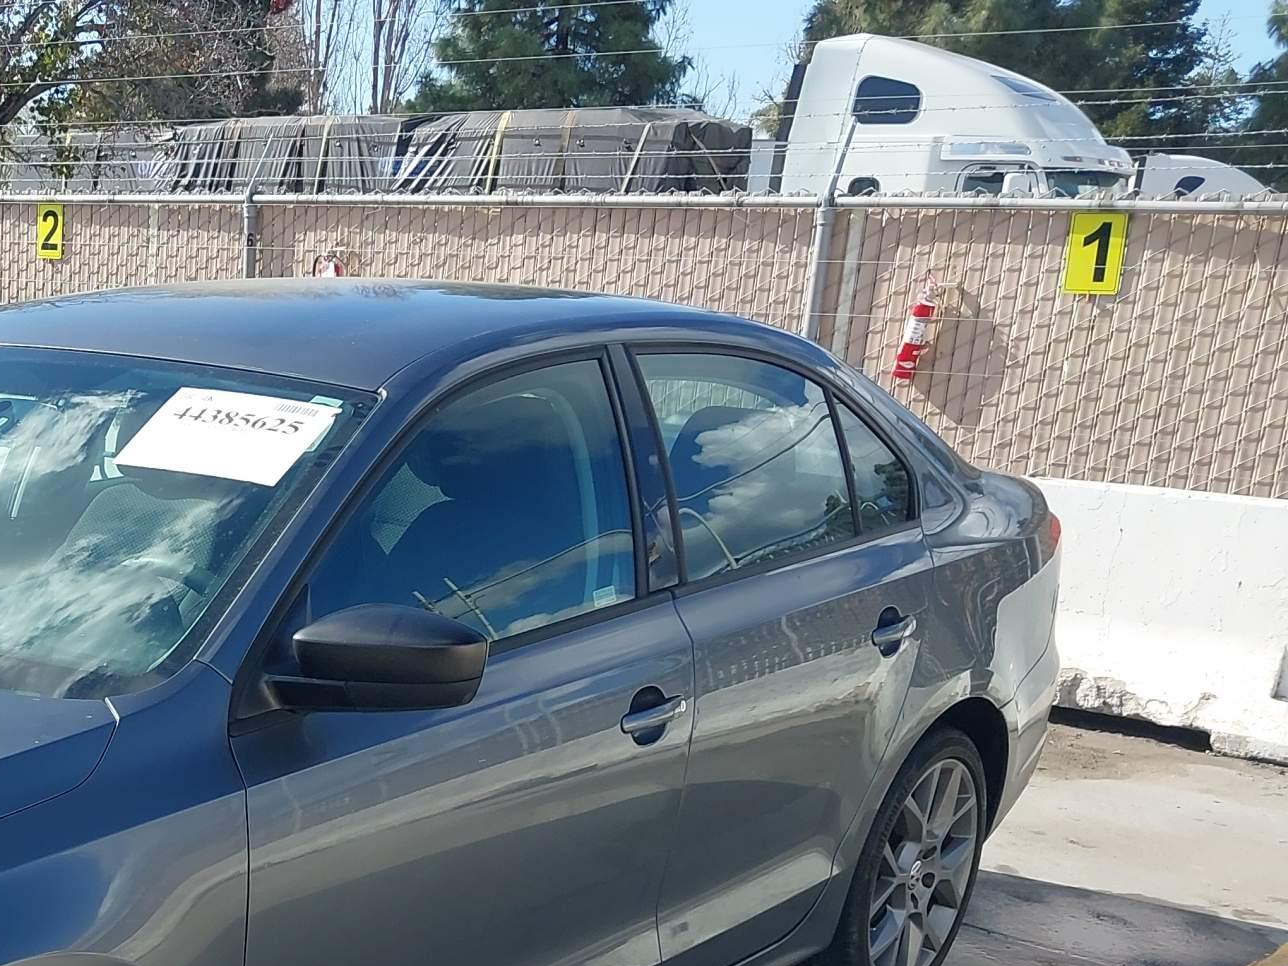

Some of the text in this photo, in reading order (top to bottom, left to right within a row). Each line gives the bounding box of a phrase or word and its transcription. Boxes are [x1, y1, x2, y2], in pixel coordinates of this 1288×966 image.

[41, 210, 59, 251] 2
[1082, 221, 1113, 283] 1
[173, 405, 306, 436] 44385625
